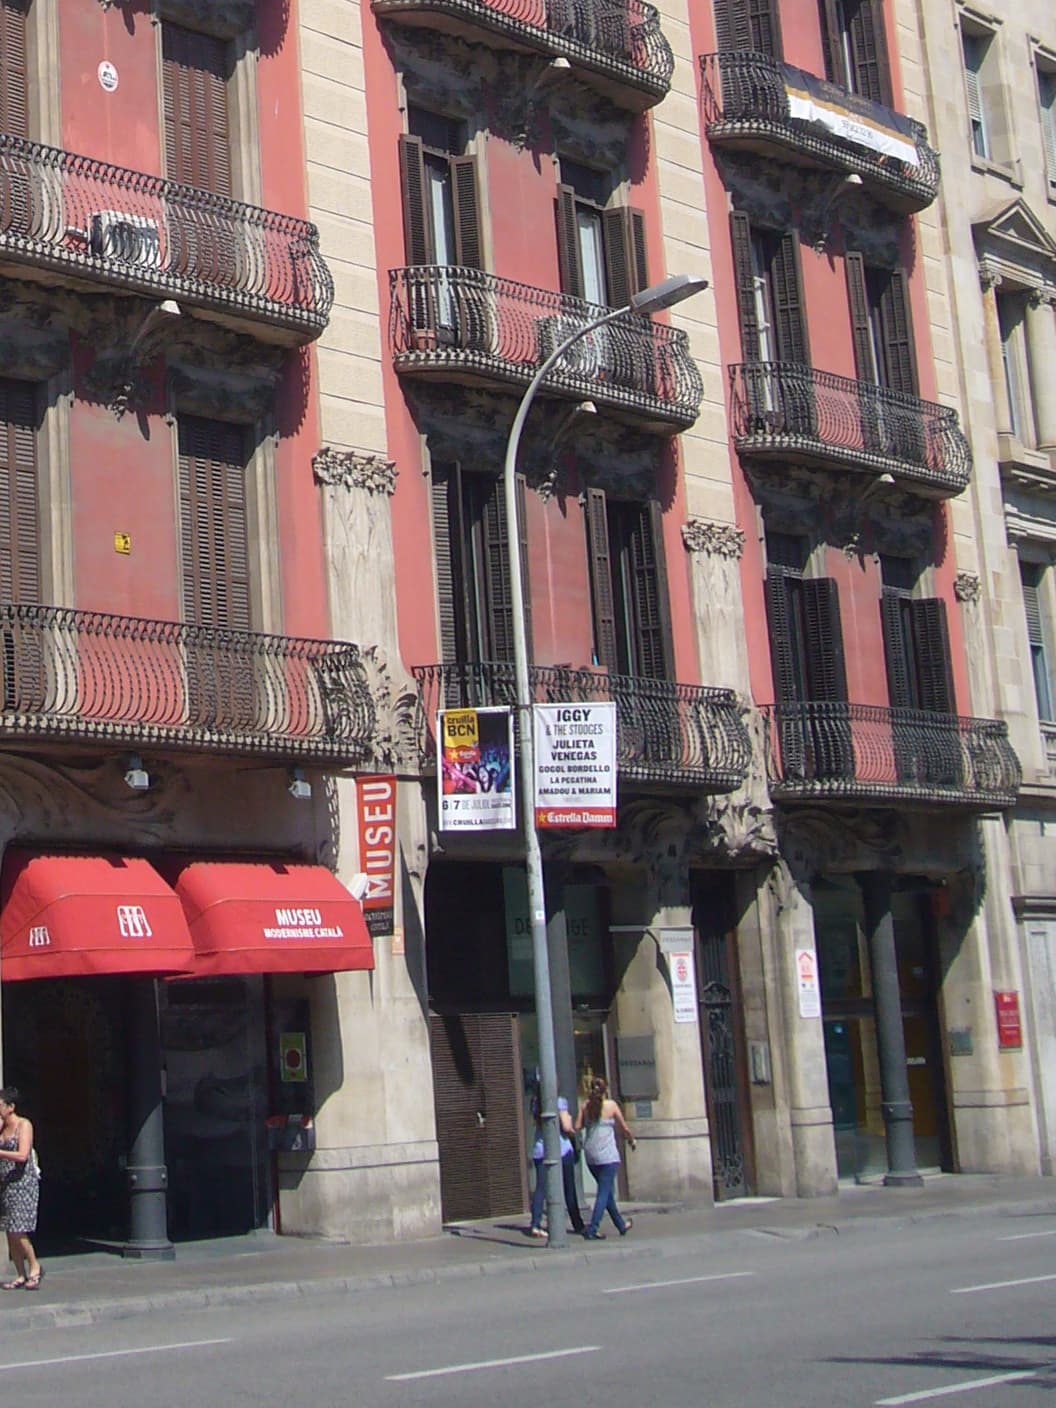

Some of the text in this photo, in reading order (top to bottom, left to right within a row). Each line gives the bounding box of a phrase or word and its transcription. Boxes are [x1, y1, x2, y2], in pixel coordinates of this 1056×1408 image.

[556, 709, 592, 722] IGGY
[447, 724, 475, 737] BCN
[554, 724, 567, 736] THE
[569, 723, 603, 735] STOOGES
[552, 739, 595, 750] JULIETA
[550, 751, 597, 761] VENEGAS
[538, 764, 611, 773] GOGOL BORDELLO
[550, 776, 559, 784] LA
[538, 787, 570, 795] AMADOU
[582, 811, 613, 824] Damm
[362, 781, 393, 900] MUSEU
[274, 908, 322, 926] MUSEU
[263, 927, 316, 939] MODERNISME
